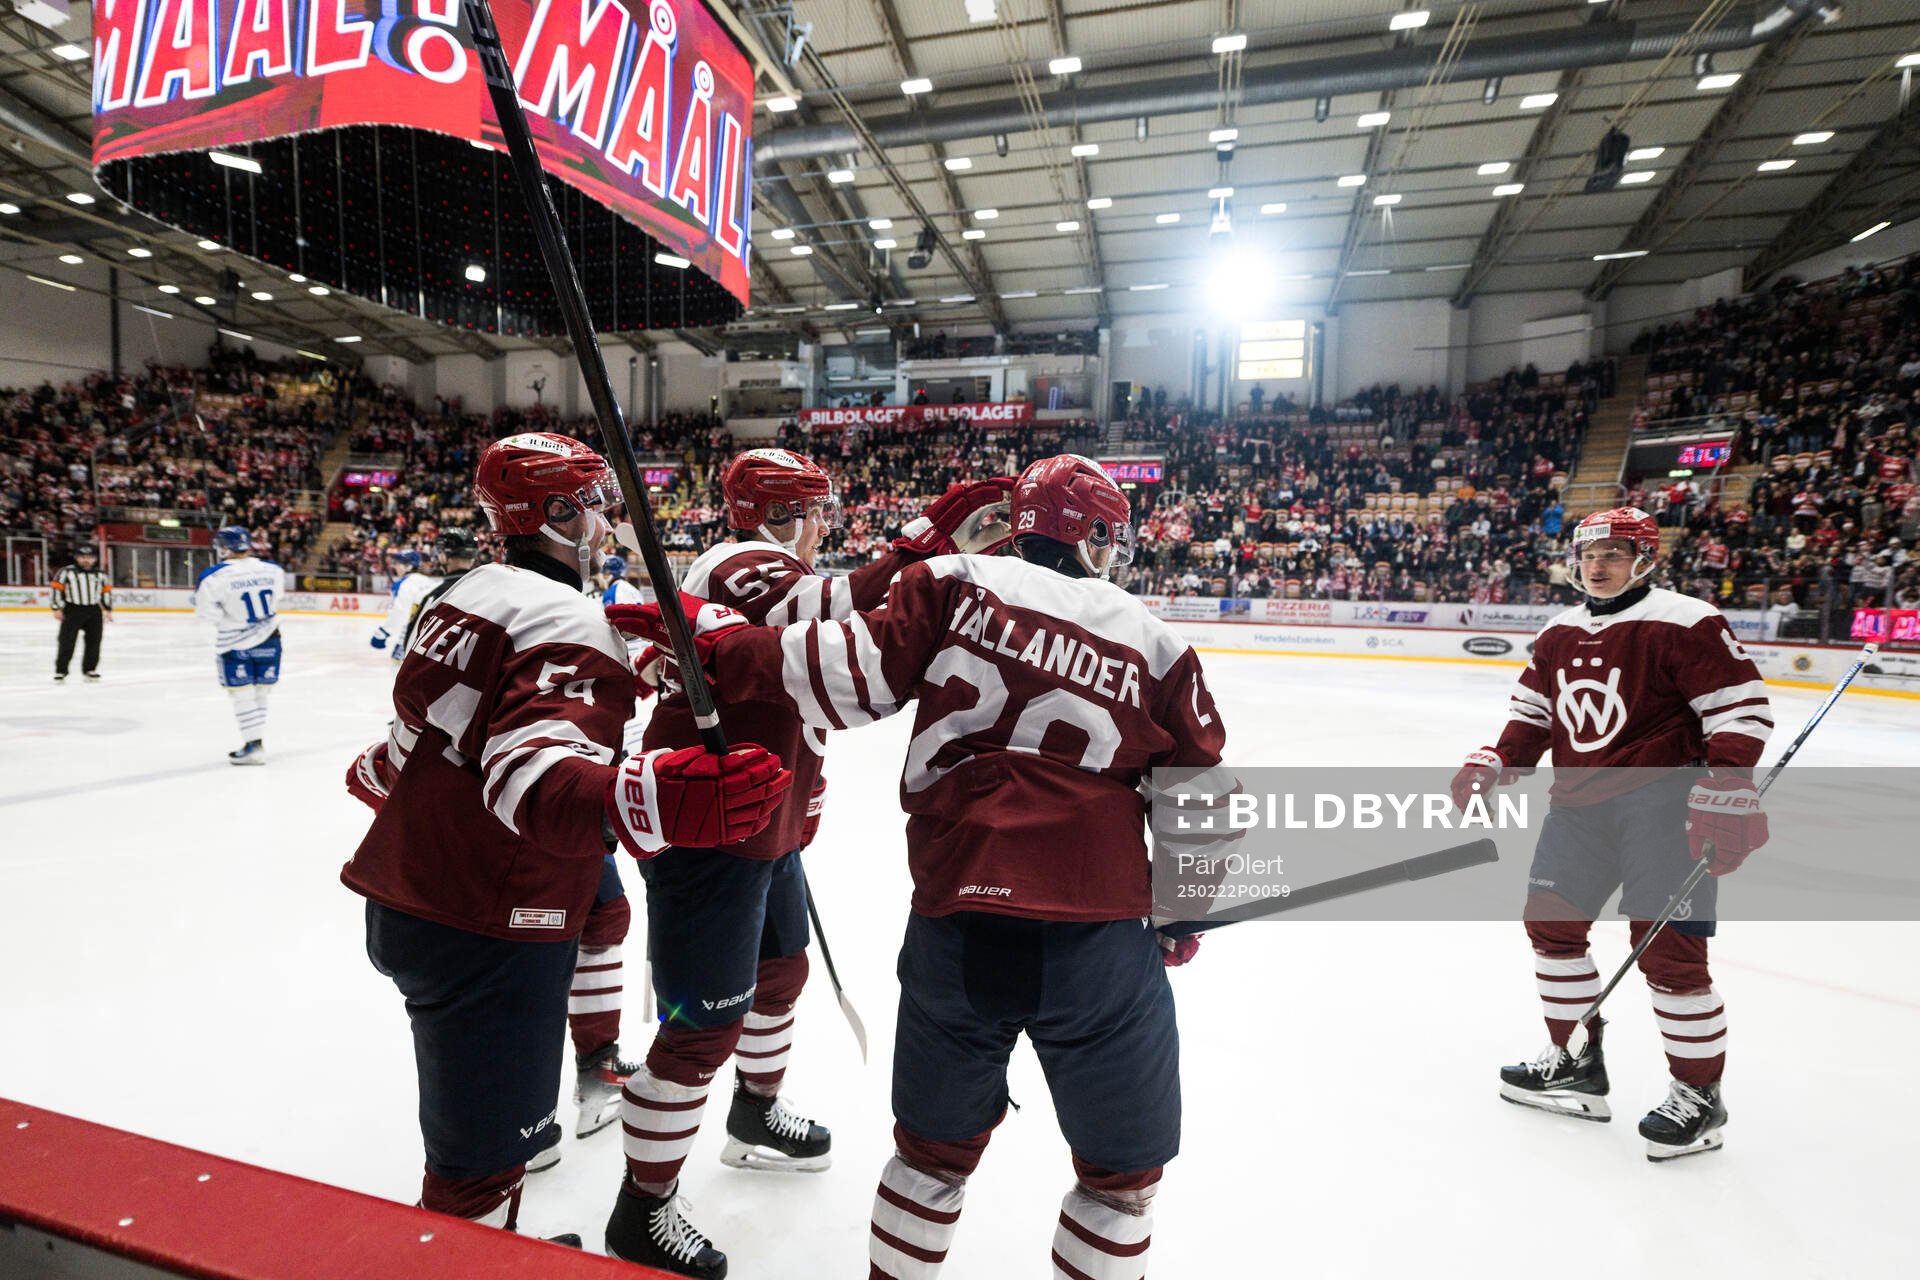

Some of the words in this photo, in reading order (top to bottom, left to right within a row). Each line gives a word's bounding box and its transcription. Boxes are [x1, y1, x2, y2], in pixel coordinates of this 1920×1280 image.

[810, 408, 905, 425] BILBOLAGET
[1018, 510, 1036, 530] 29
[330, 597, 360, 611] ABB
[1266, 601, 1330, 611] PIZZERIA
[1254, 633, 1336, 645] Handelsbanken
